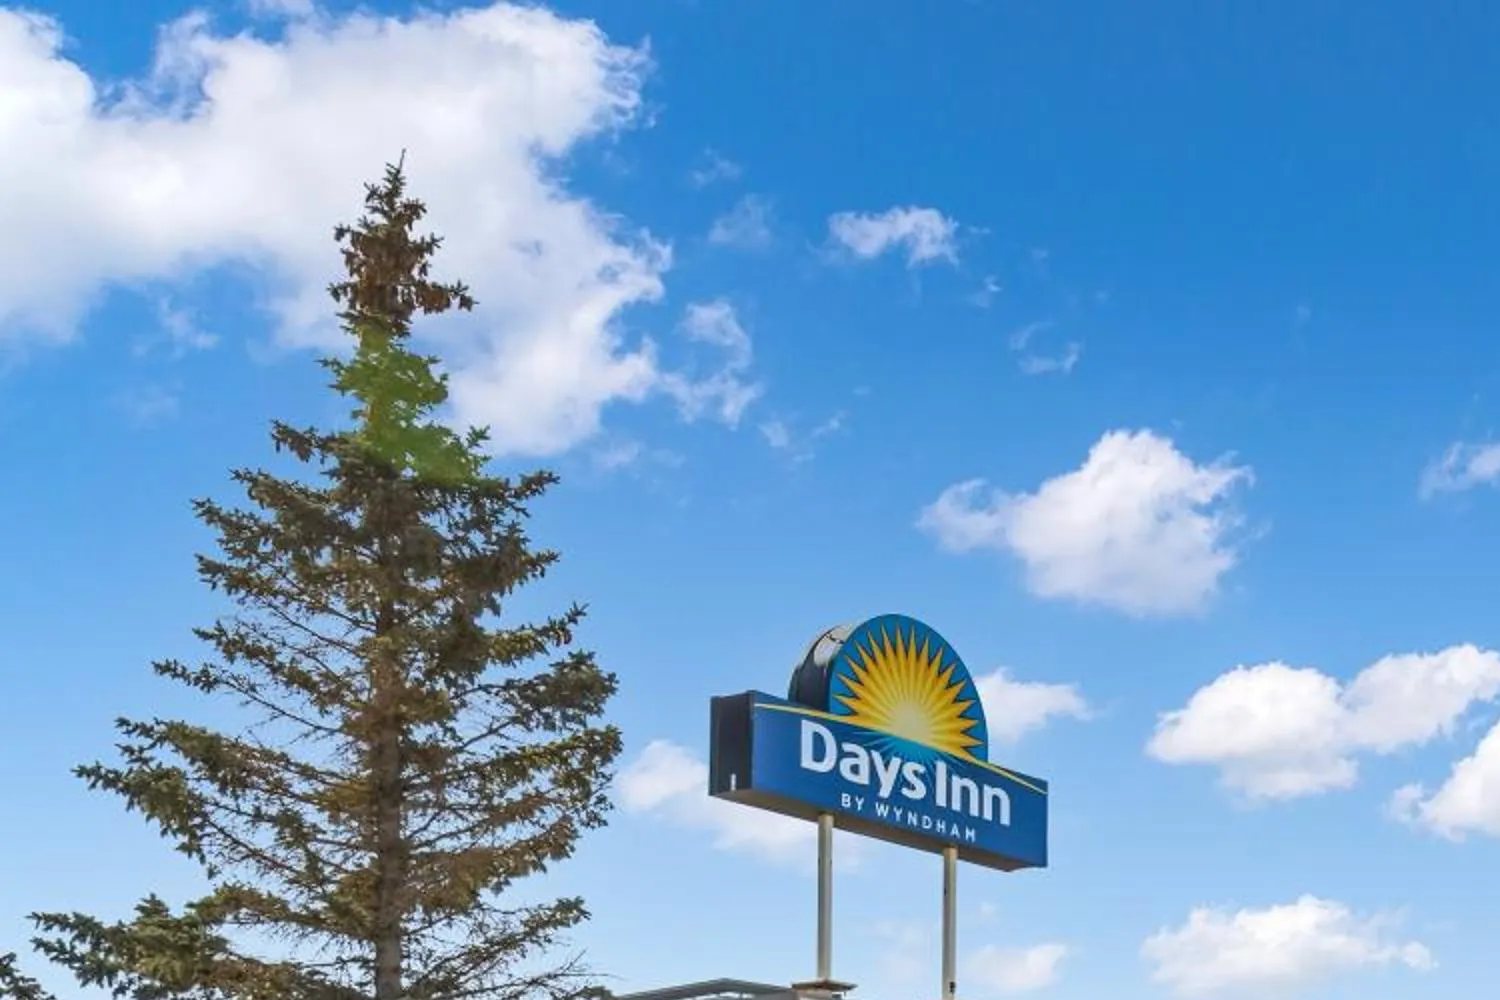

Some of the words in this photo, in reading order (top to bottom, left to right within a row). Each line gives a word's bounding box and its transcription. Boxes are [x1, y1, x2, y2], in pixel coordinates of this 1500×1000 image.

[801, 719, 927, 800] Days
[935, 759, 1011, 827] Inn
[841, 793, 865, 811] BY
[875, 803, 977, 842] WYNDHAM
